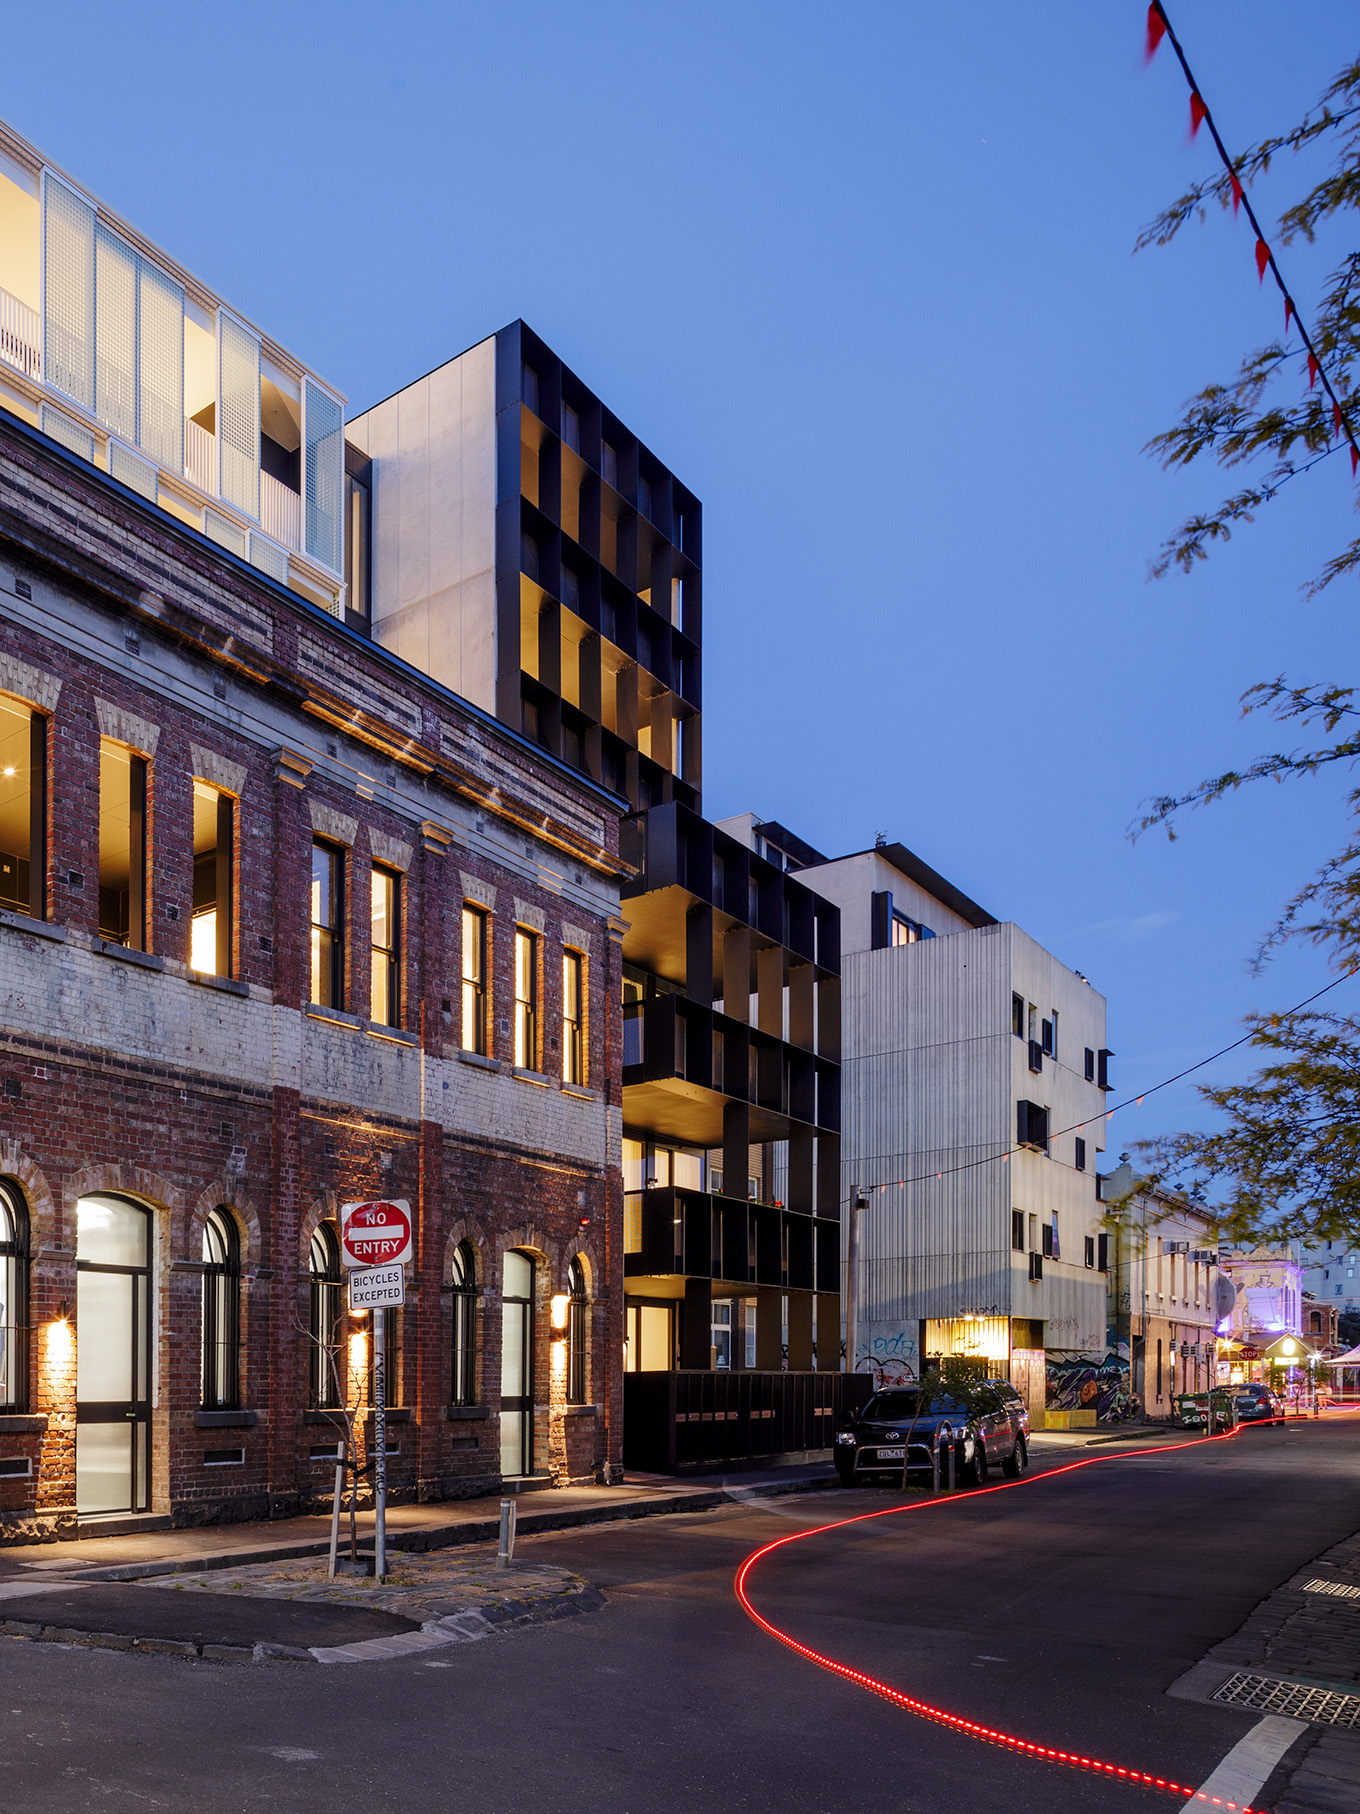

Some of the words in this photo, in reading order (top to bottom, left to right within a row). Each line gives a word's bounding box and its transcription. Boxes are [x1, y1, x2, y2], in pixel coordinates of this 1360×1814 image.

[366, 1212, 387, 1225] NO
[354, 1240, 400, 1255] ENTRY
[353, 1272, 400, 1287] BICYCLES
[353, 1288, 400, 1303] EXCEPTED
